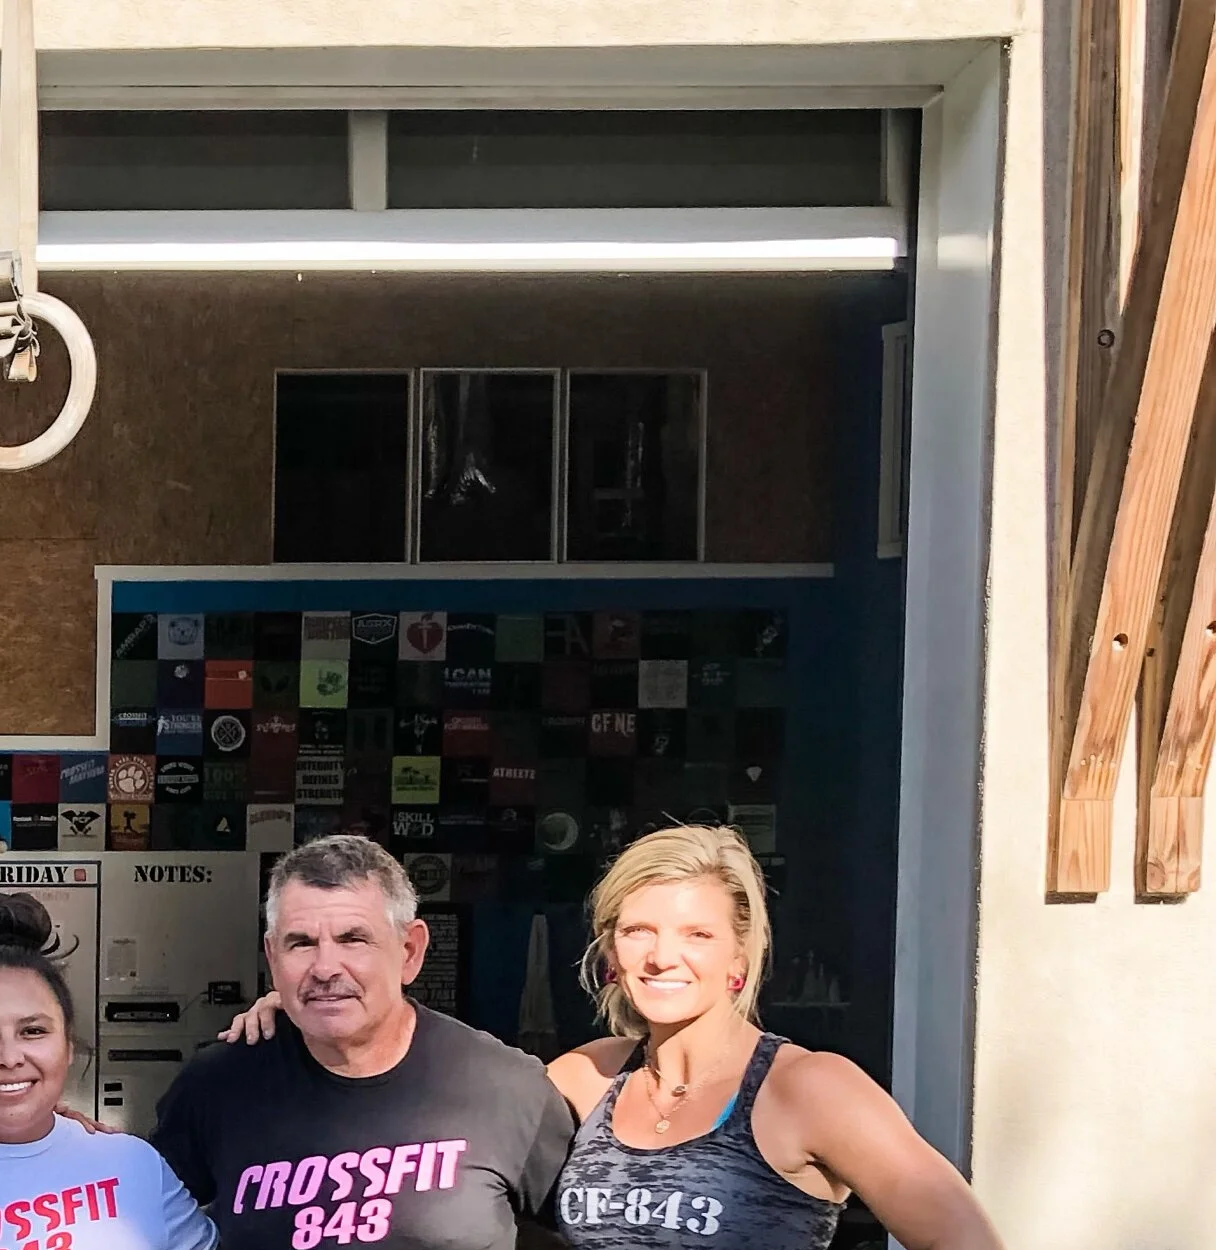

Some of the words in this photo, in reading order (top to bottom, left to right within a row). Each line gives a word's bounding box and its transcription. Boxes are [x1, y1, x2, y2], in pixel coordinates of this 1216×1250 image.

[452, 667, 492, 680] CAN
[398, 811, 434, 823] SKILL
[392, 821, 435, 836] WD
[134, 865, 212, 883] NOTES:
[233, 1139, 467, 1214] CROSSFIT
[560, 1187, 724, 1236] CF-843
[291, 1198, 393, 1250] 843
